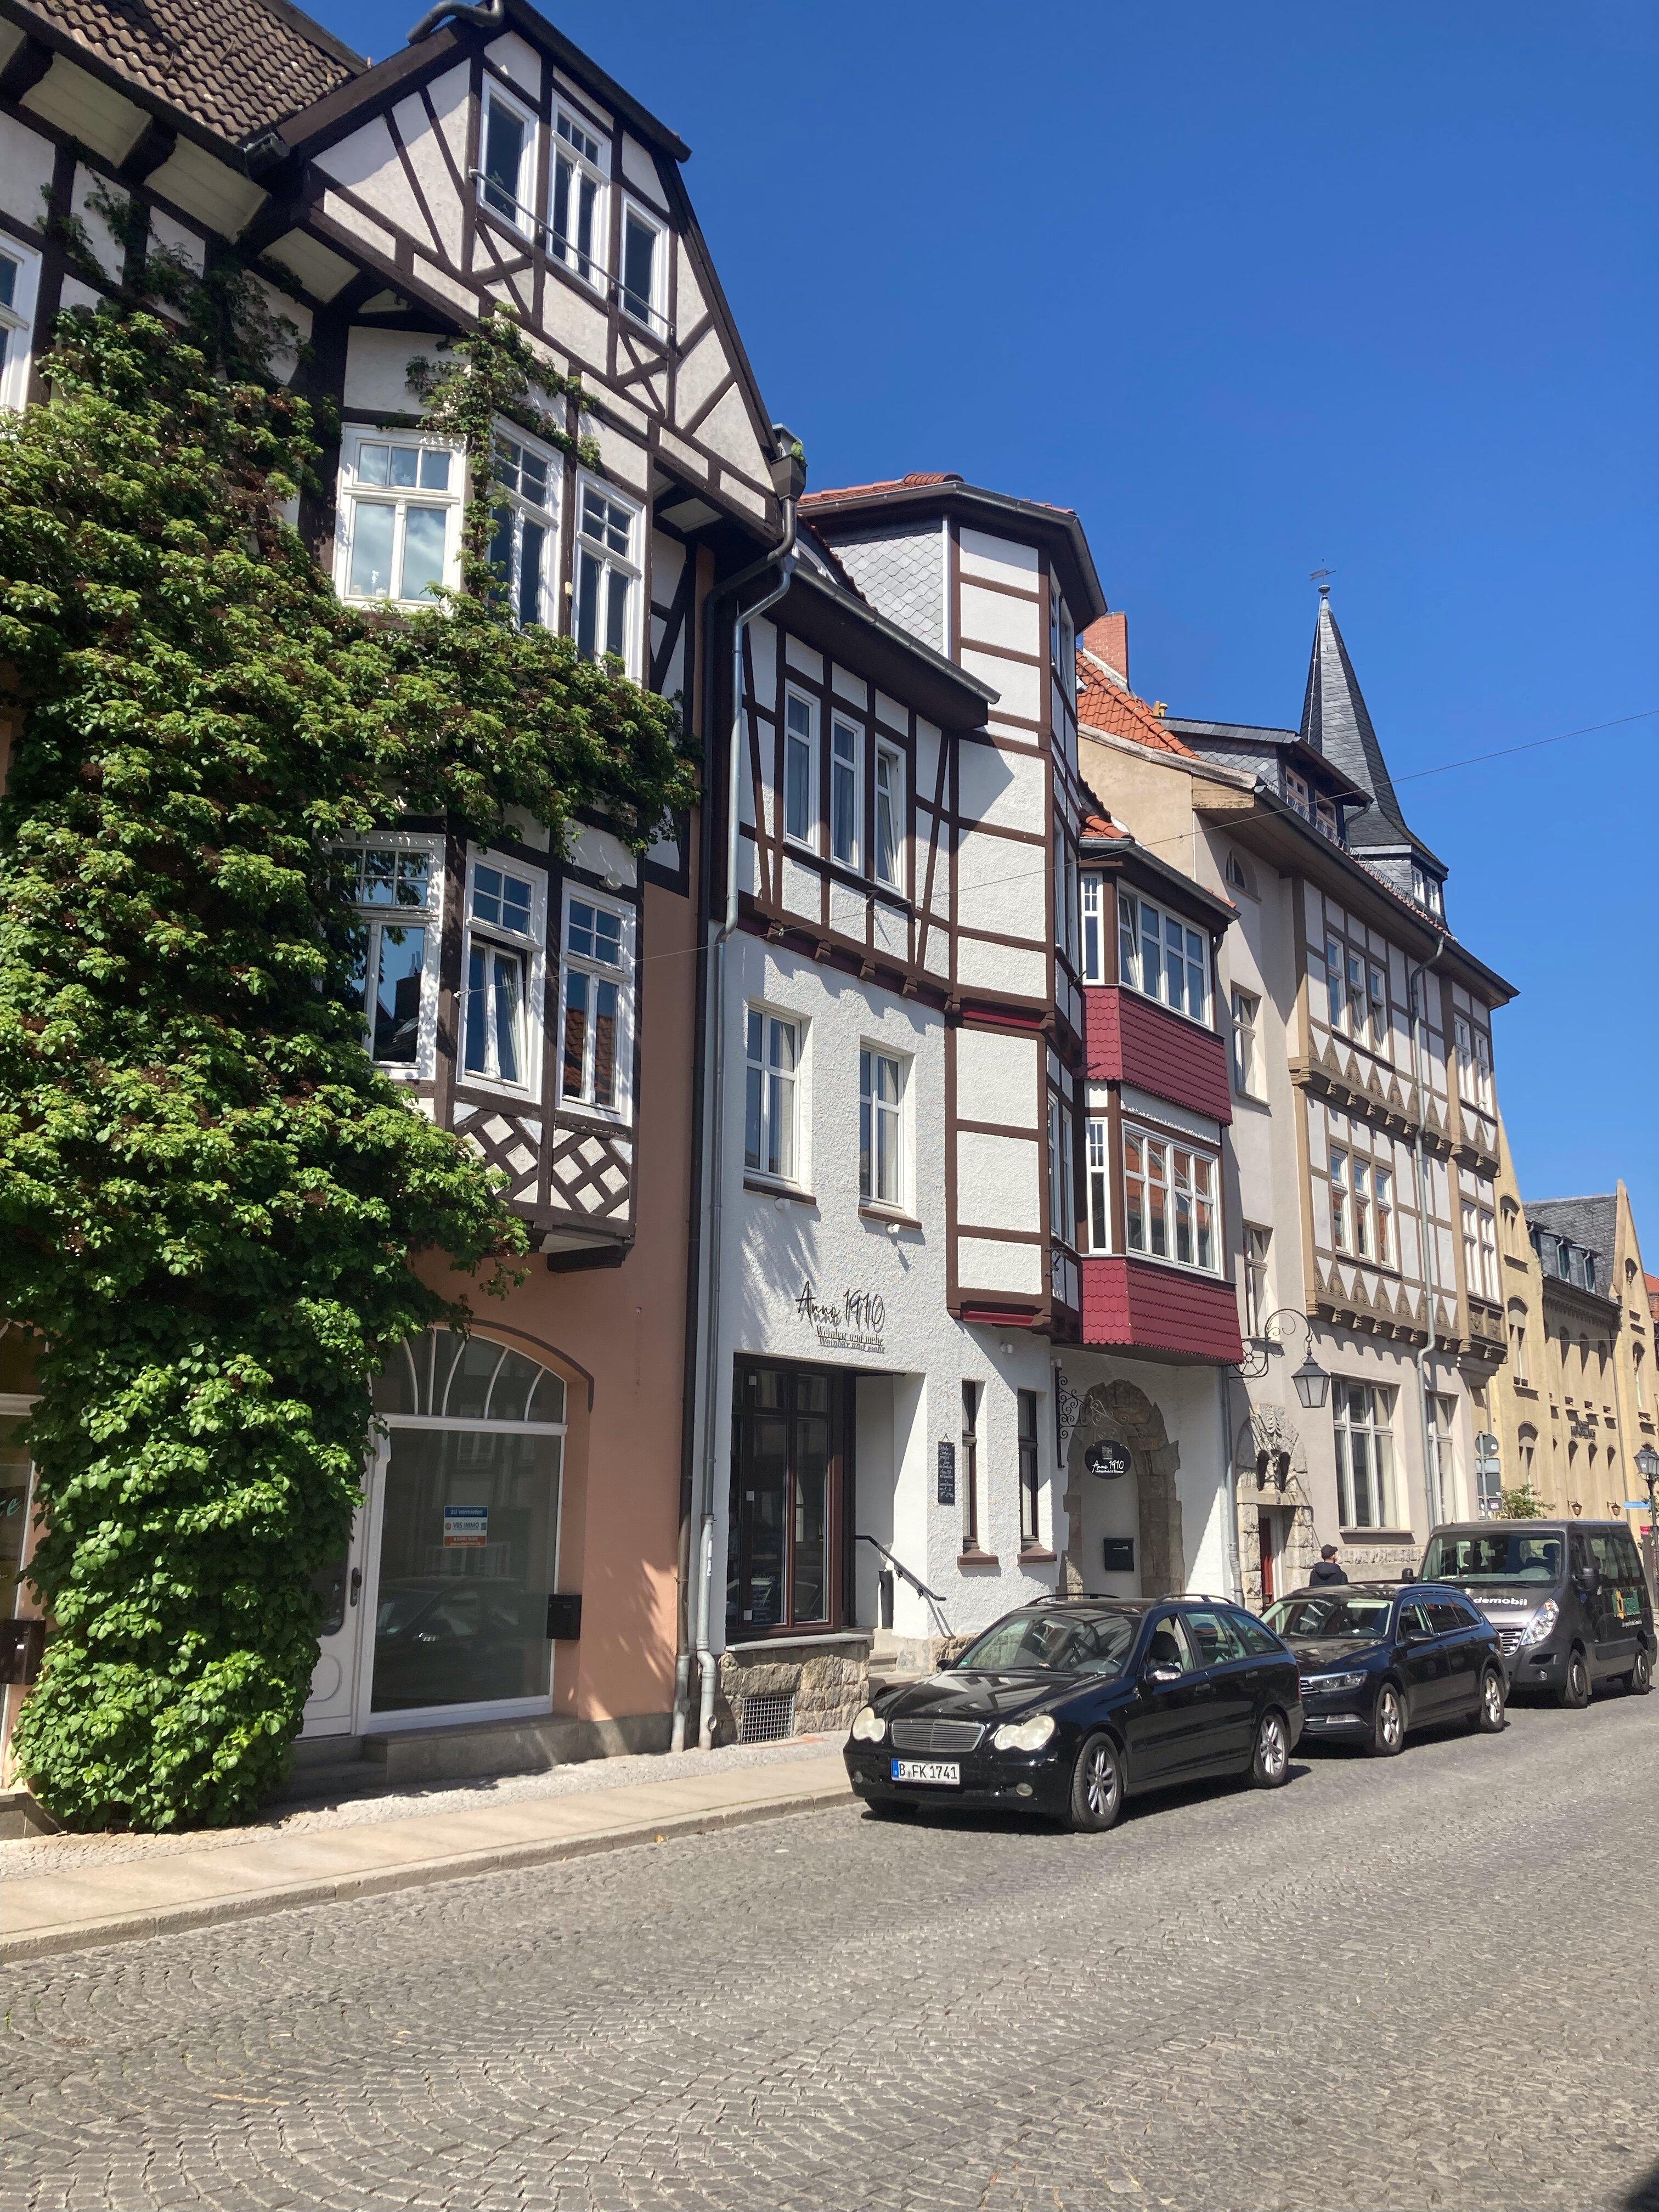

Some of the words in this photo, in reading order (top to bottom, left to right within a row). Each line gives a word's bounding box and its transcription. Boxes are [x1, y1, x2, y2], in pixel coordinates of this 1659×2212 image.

[795, 1281, 840, 1320] Anno
[843, 1288, 883, 1324] 1910
[816, 1325, 848, 1339] Weinbar
[850, 1332, 864, 1343] und
[865, 1334, 884, 1346] mehr
[1109, 1460, 1125, 1470] 1910
[899, 1763, 906, 1776] B
[912, 1764, 927, 1778] FK
[929, 1765, 958, 1779] 1741
